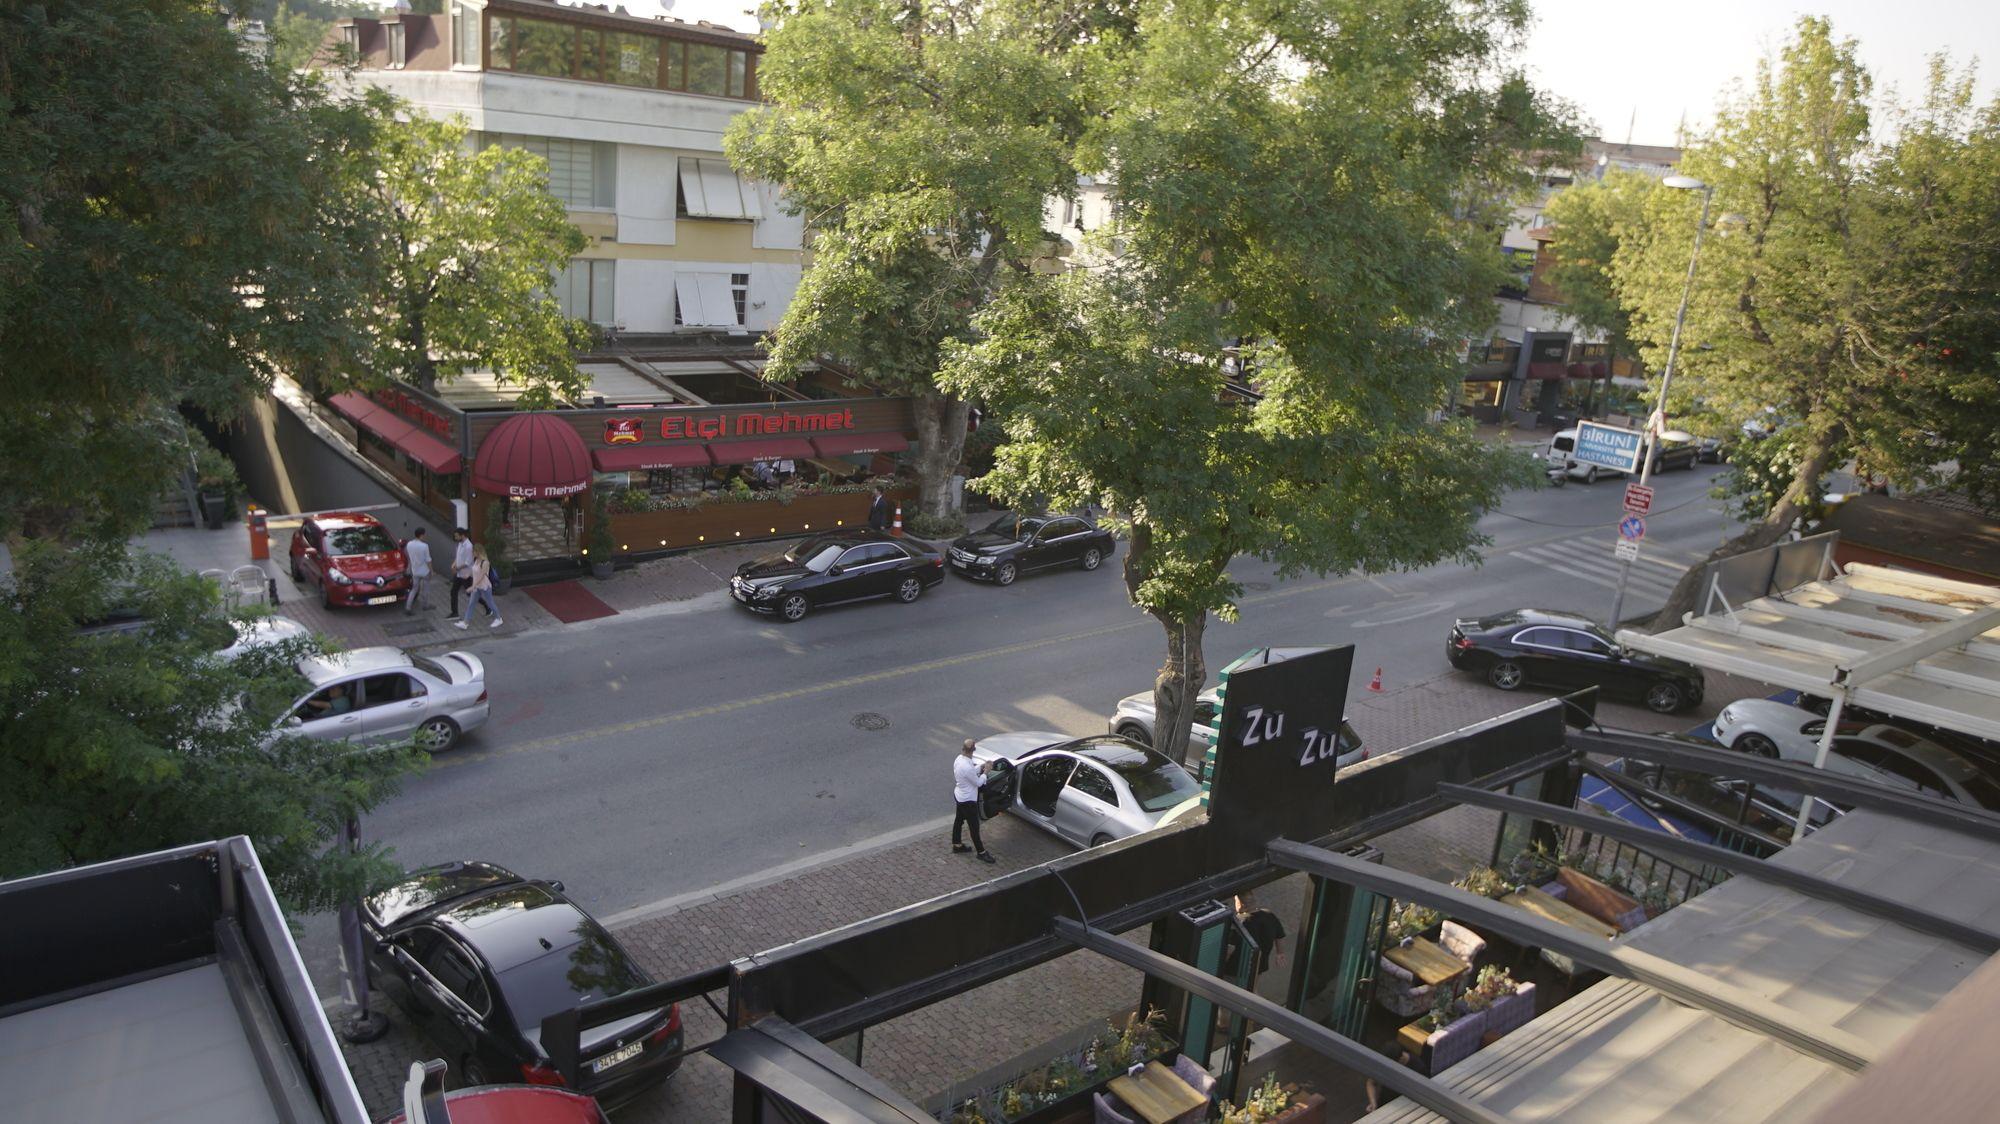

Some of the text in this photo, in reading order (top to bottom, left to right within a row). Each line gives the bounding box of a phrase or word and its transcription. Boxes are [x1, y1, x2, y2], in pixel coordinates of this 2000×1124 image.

[661, 408, 854, 440] Etçi Mehmet
[510, 481, 586, 497] Etçi Mehmet
[1242, 706, 1284, 747] Zu
[1300, 728, 1336, 767] Zu
